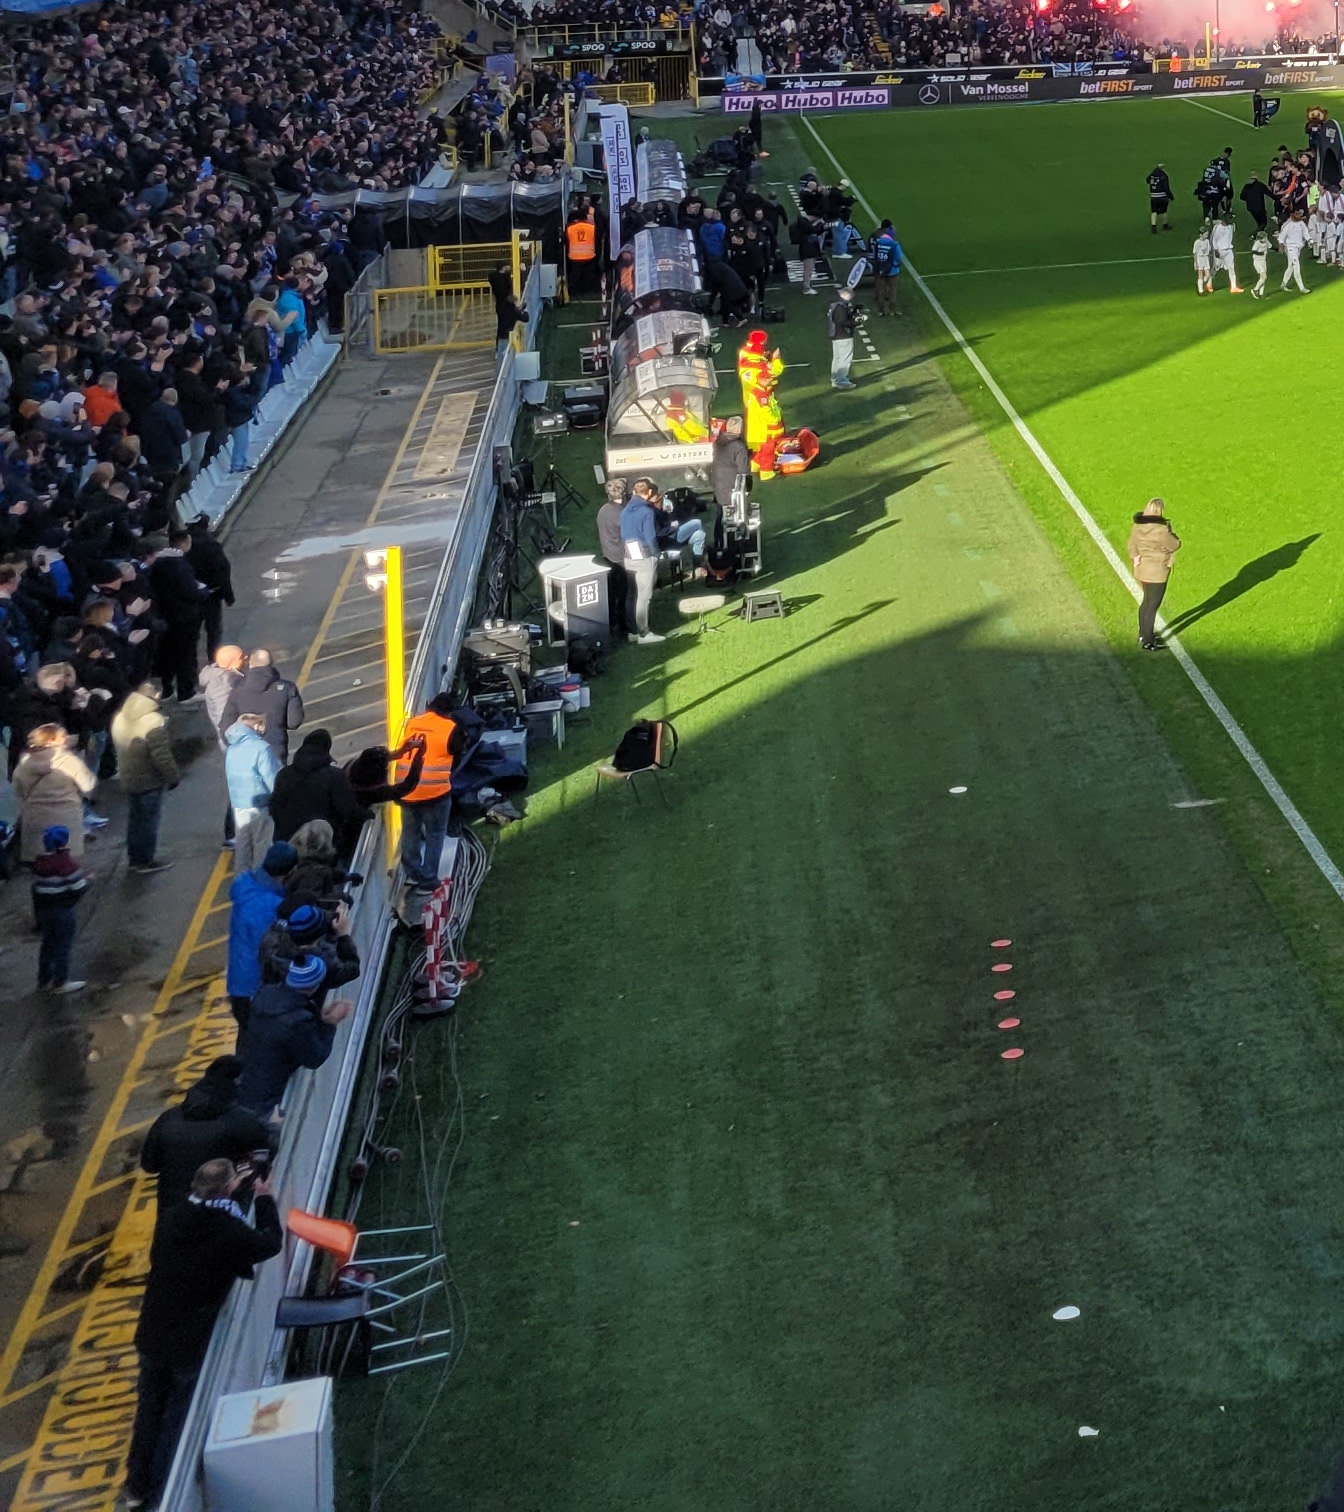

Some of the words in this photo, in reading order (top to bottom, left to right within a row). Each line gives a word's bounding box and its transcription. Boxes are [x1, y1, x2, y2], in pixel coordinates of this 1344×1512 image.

[1174, 74, 1227, 89] betFIRST
[1265, 71, 1317, 85] betFIRST
[960, 85, 984, 96] Van
[987, 82, 1029, 95] Mossel
[1080, 79, 1135, 94] betFIRST
[727, 97, 776, 111] Huo
[784, 94, 831, 108] Hubo
[840, 92, 886, 105] Hubo
